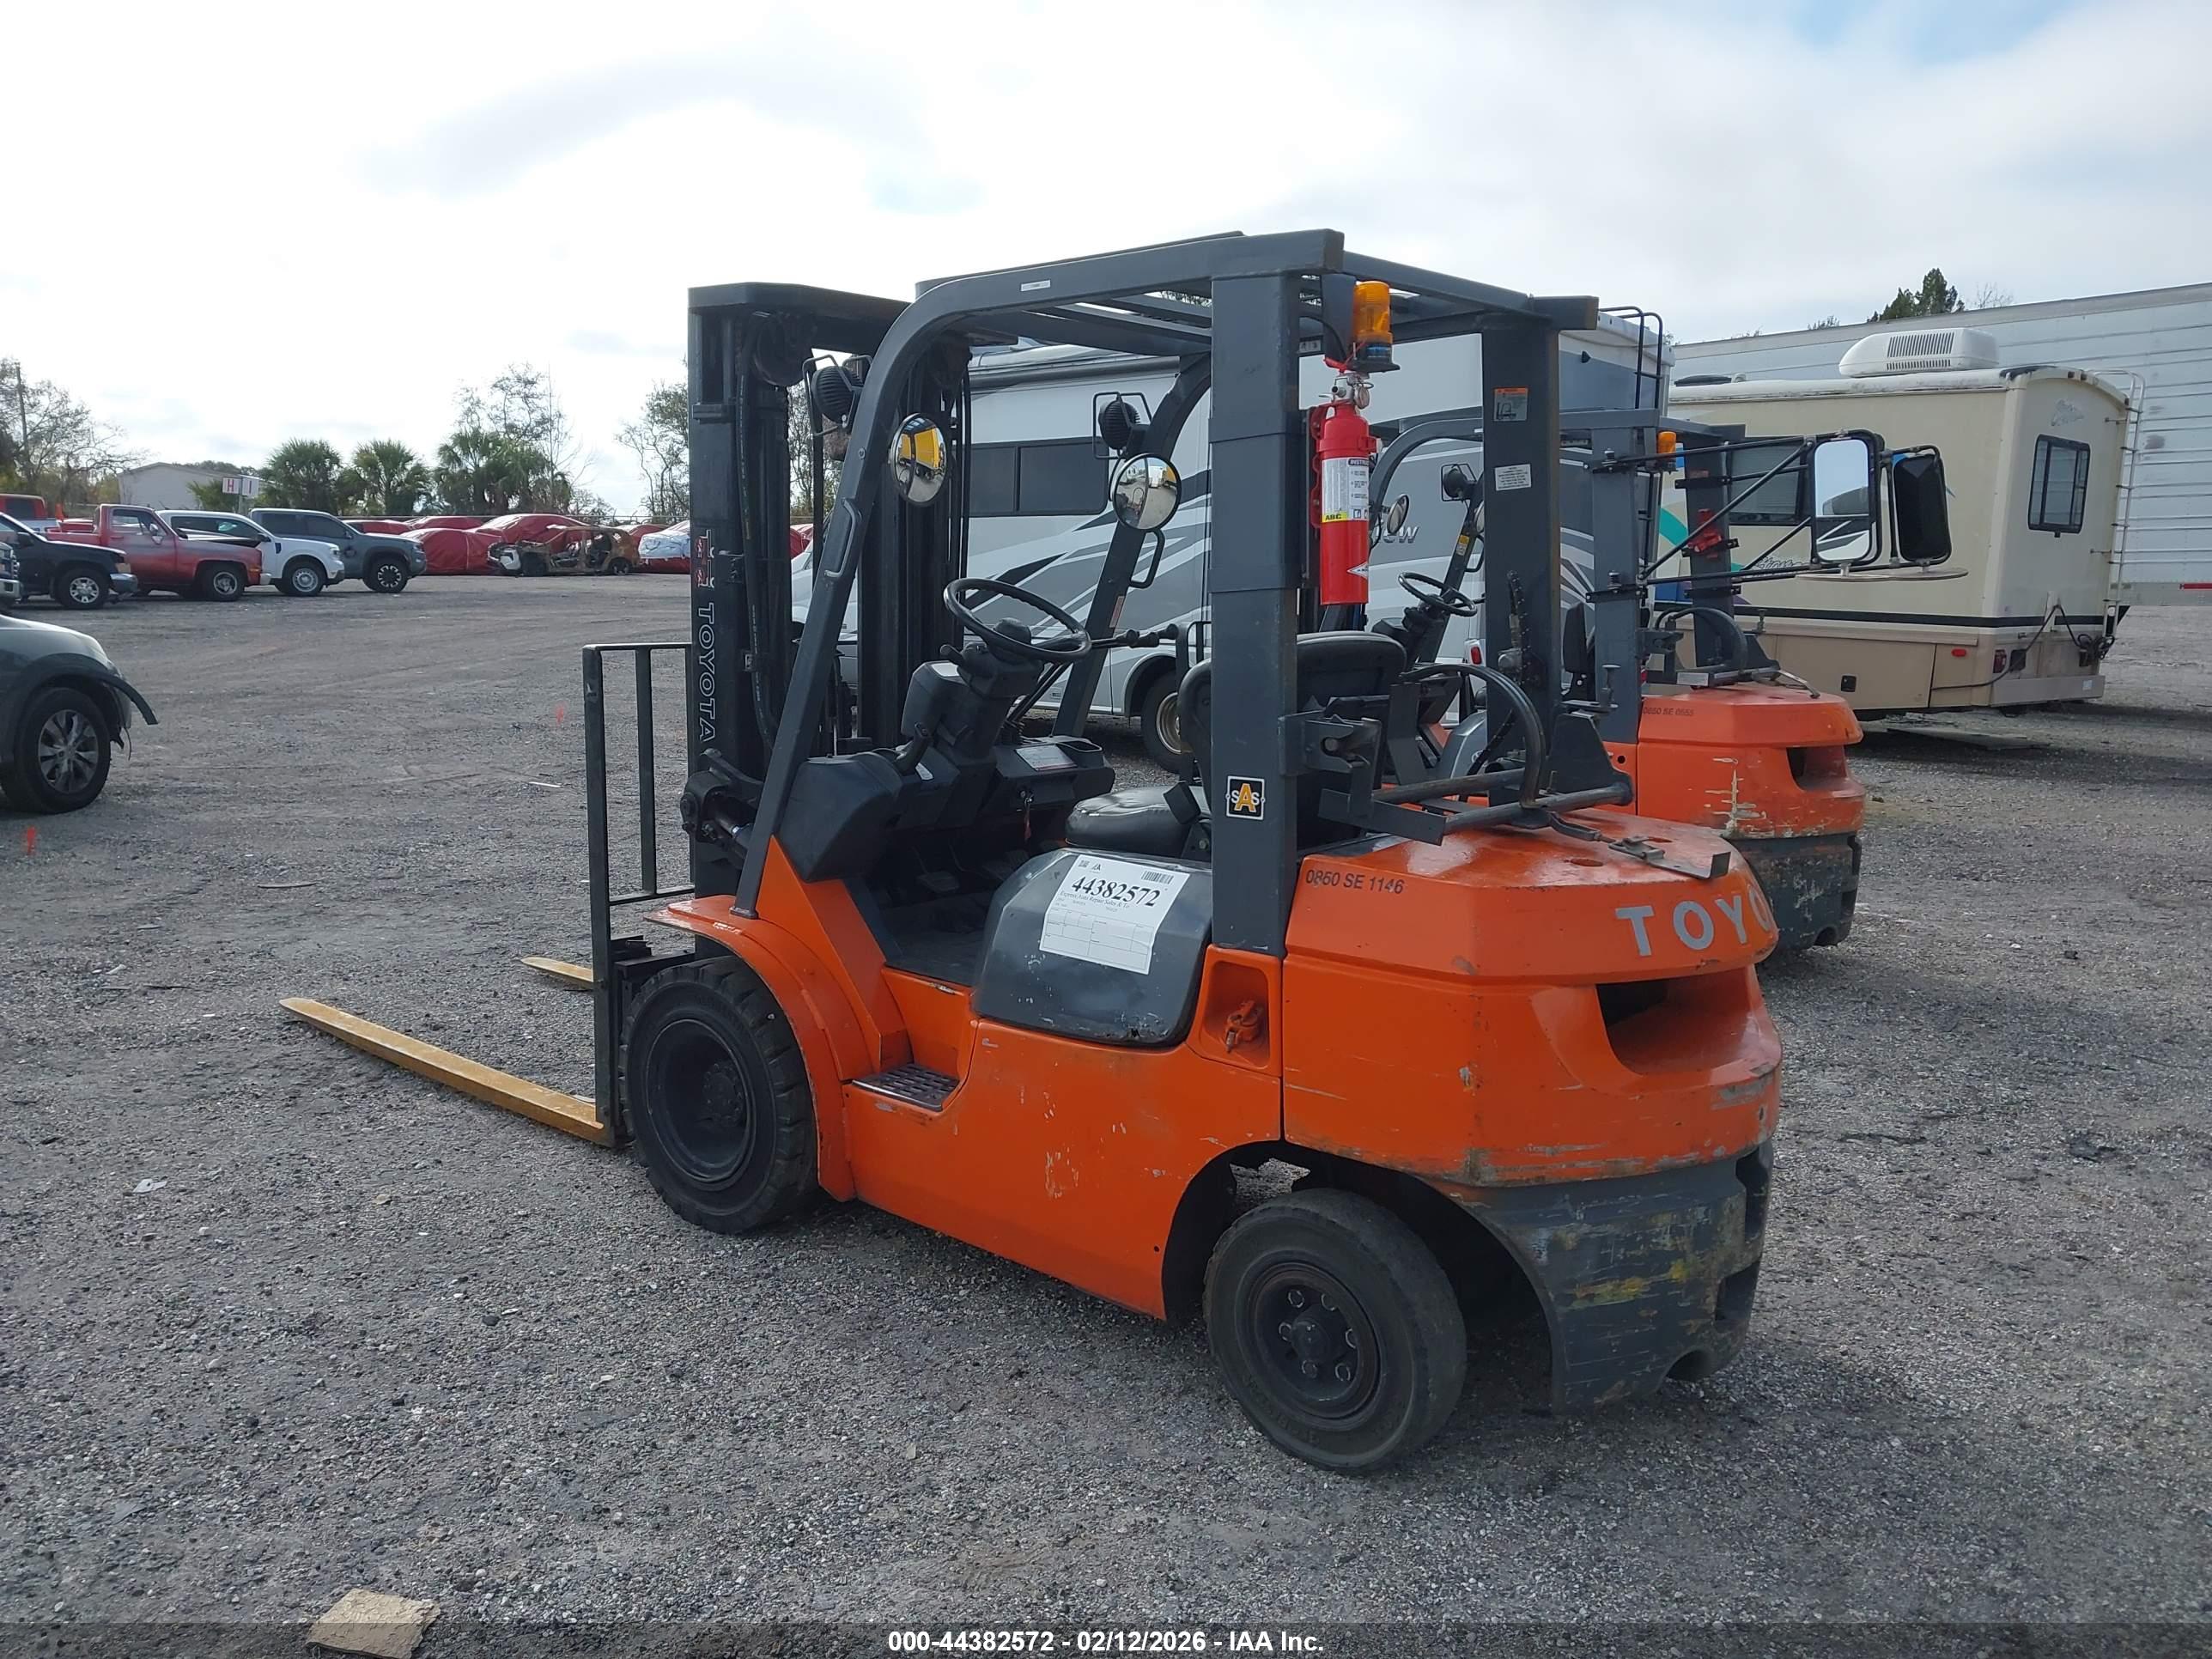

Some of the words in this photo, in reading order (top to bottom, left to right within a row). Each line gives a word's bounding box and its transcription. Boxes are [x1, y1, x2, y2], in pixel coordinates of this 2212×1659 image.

[227, 479, 234, 492] H
[698, 602, 715, 742] TOYOTA
[1231, 783, 1260, 812] SAS
[1072, 877, 1160, 907] 44382572
[1343, 873, 1365, 889] SE
[1370, 877, 1405, 894] 1146
